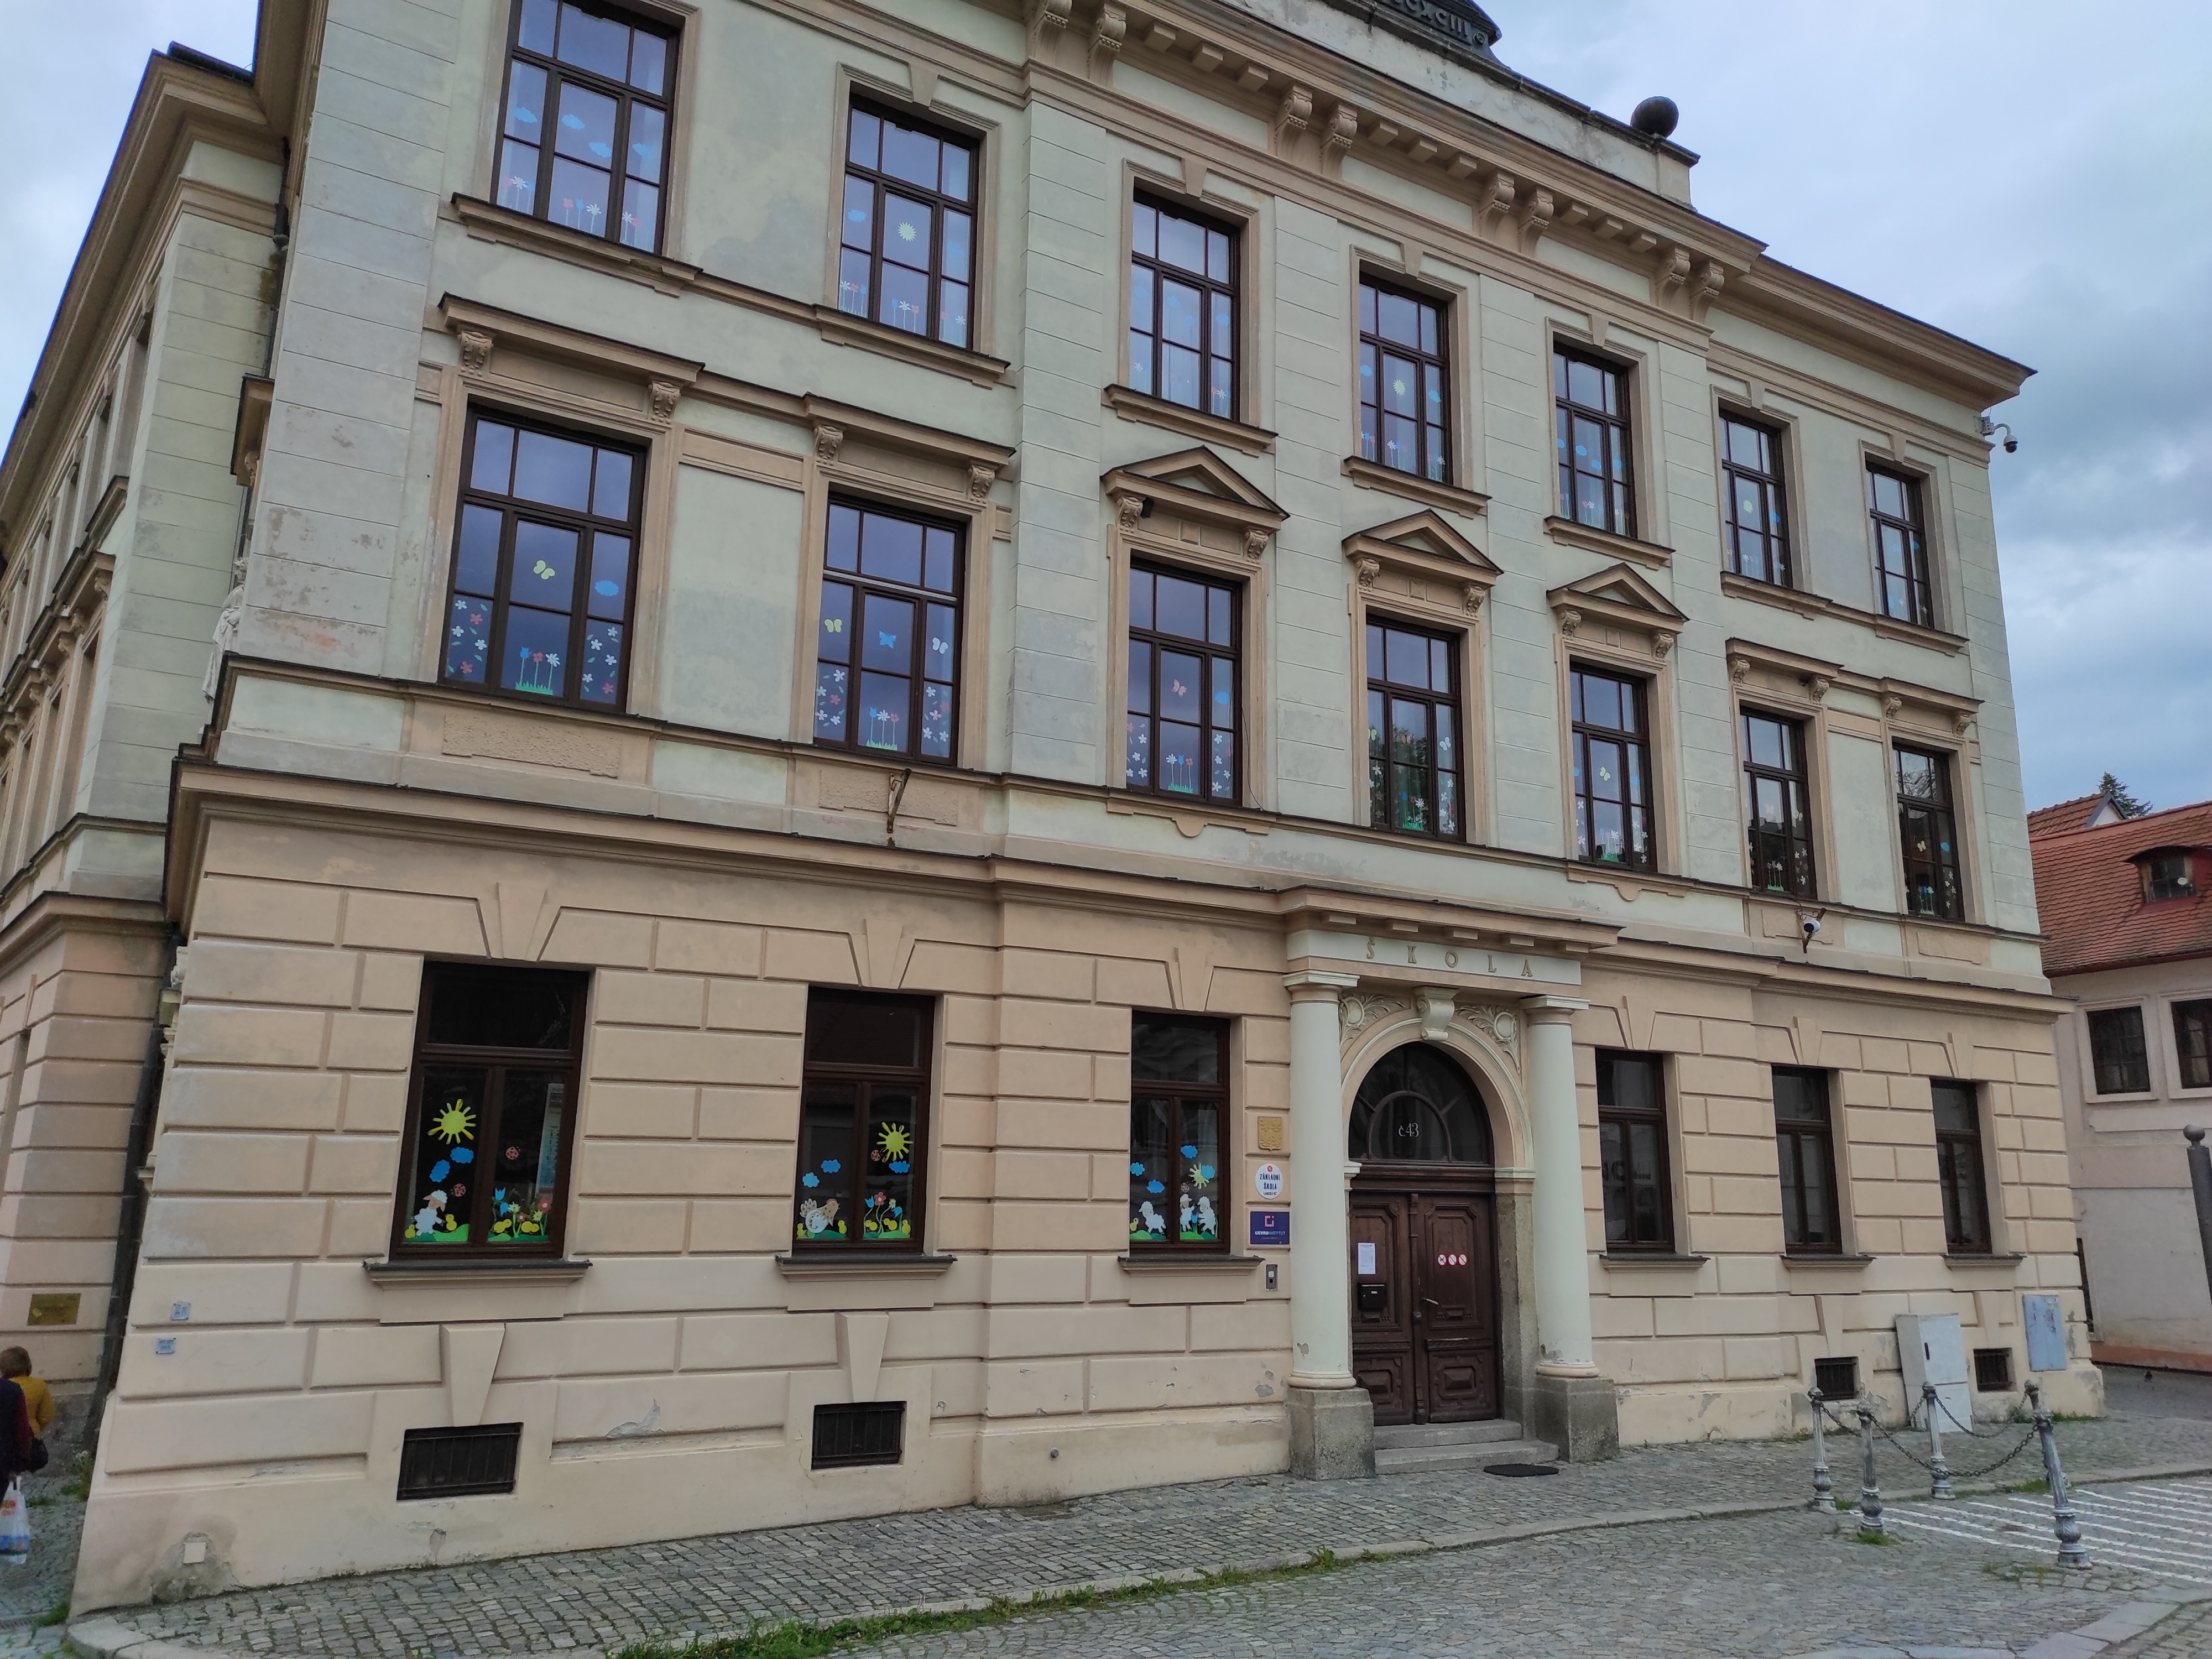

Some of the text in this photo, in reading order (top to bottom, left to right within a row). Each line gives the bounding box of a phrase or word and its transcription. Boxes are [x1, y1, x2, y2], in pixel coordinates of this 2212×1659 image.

[1394, 0, 1468, 36] CXCIII
[1366, 937, 1533, 977] ŠKOLA
[1259, 1172, 1280, 1181] ZÁKLADNÍ
